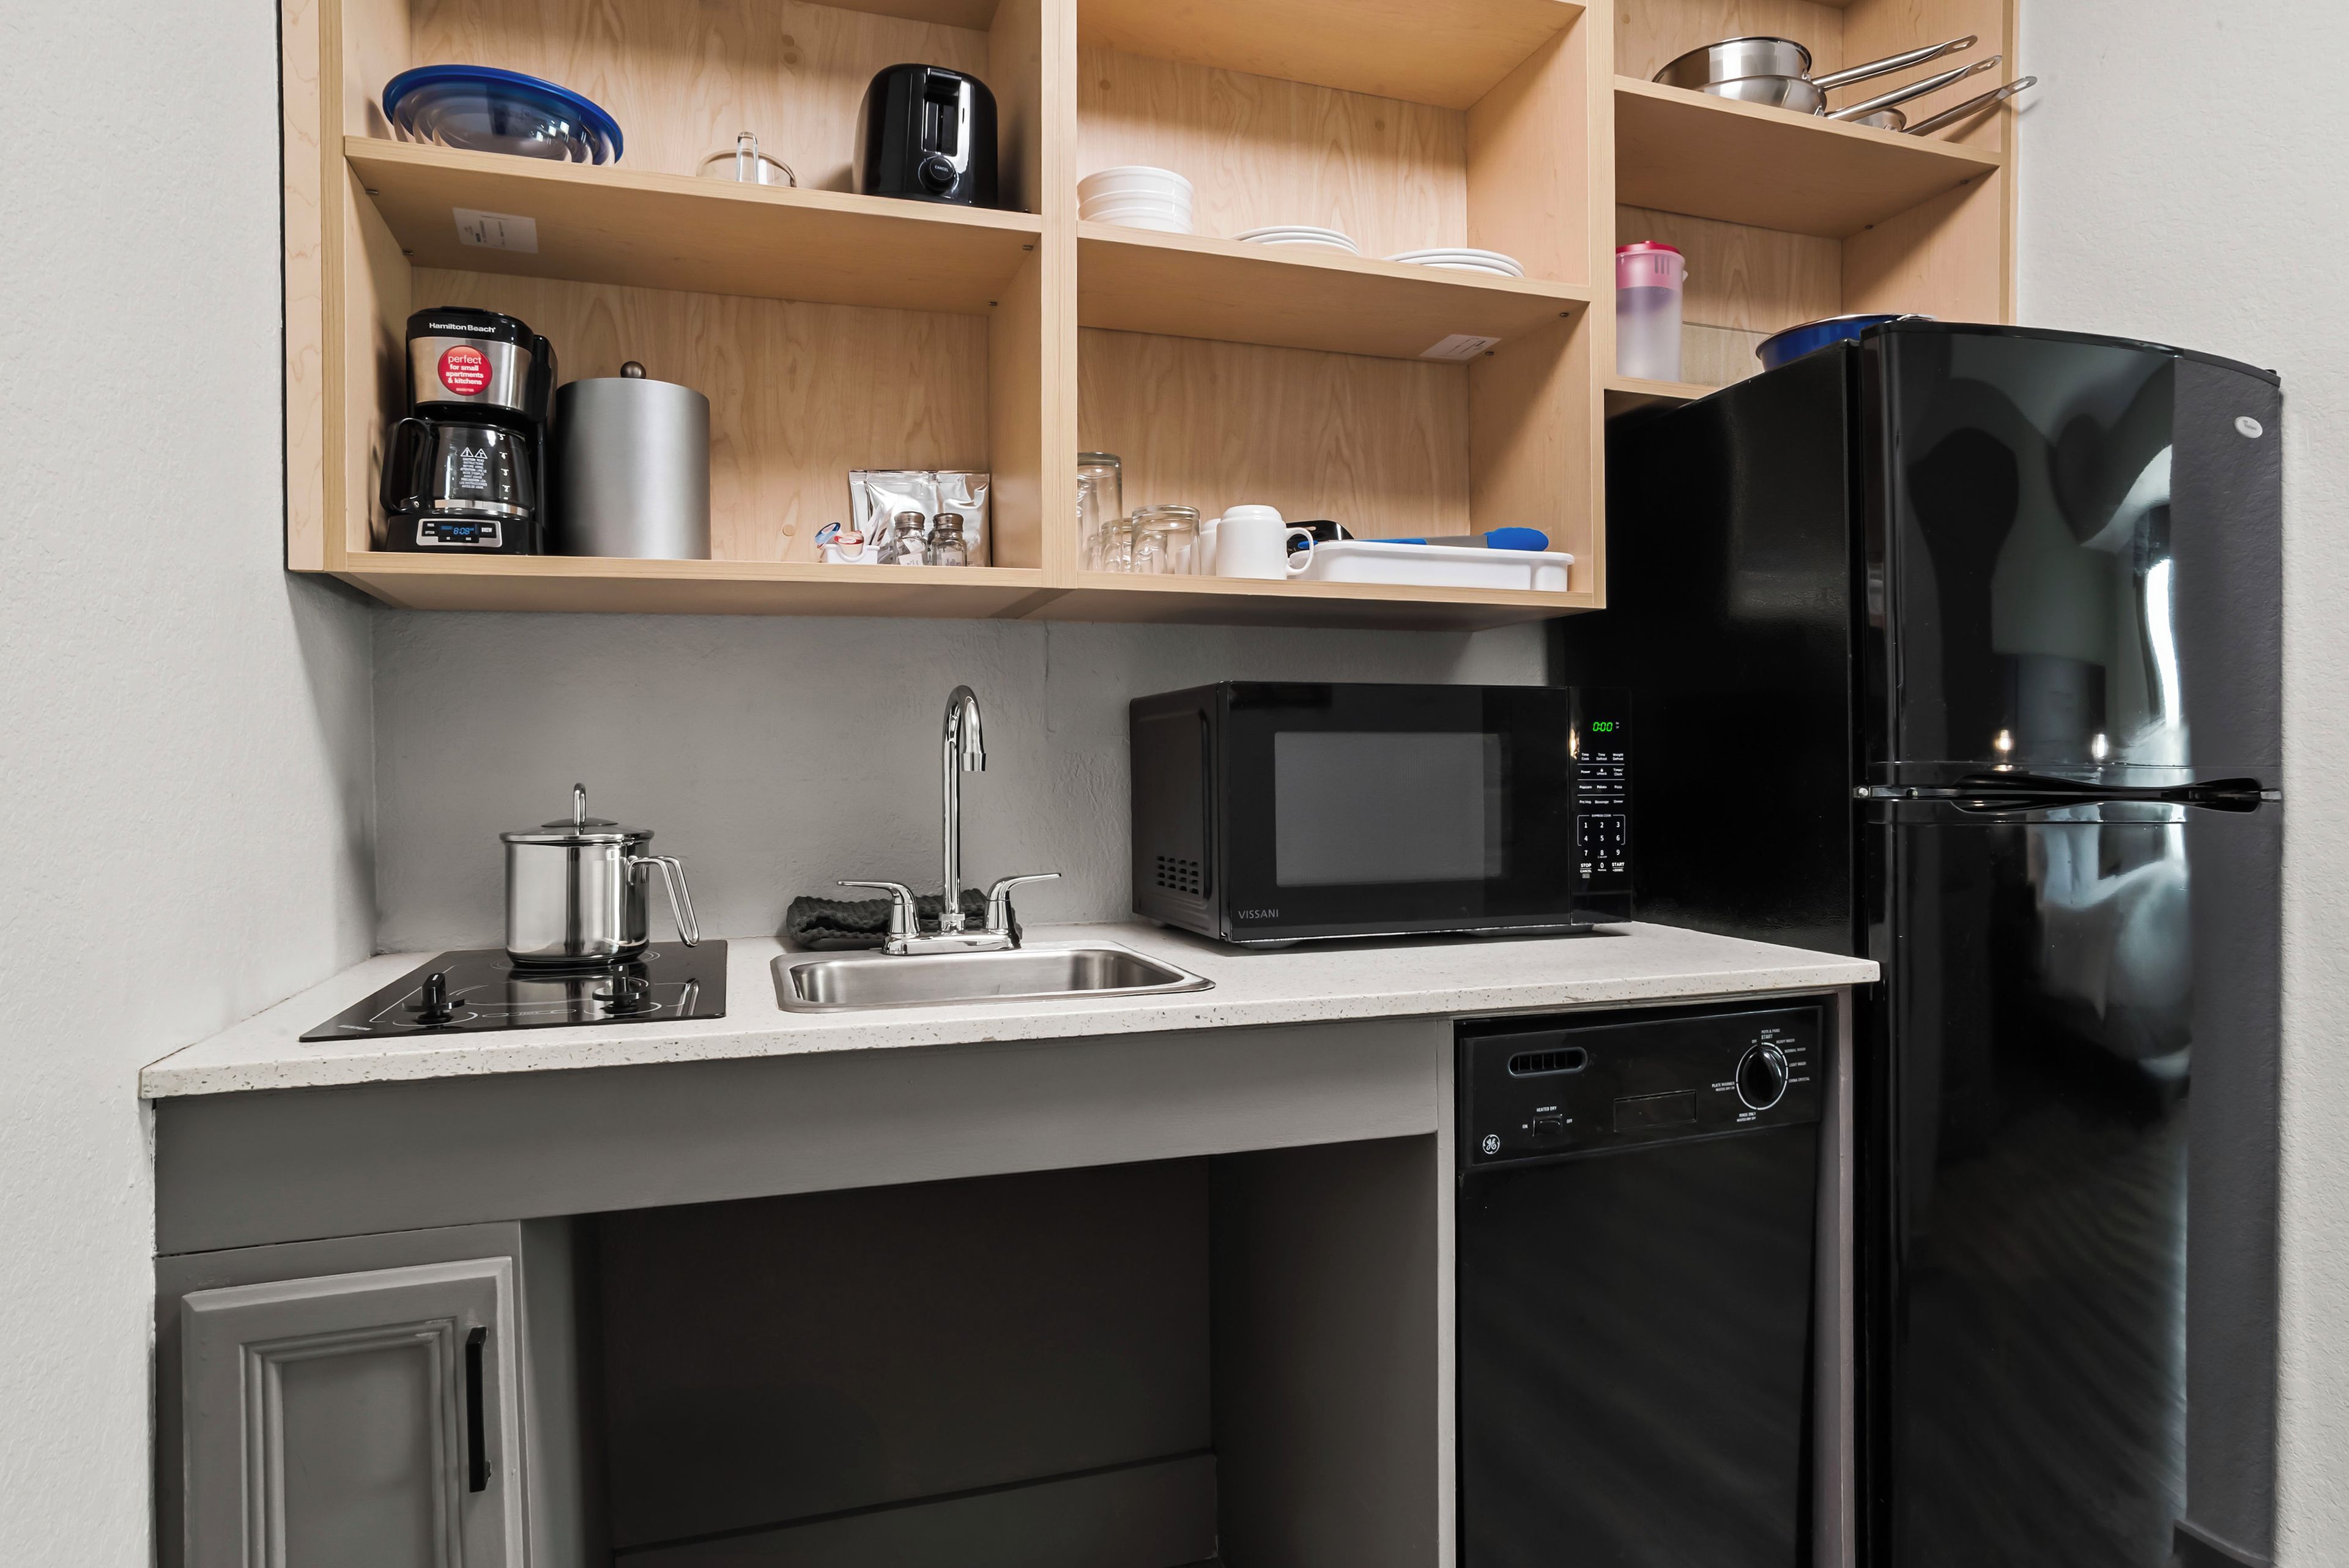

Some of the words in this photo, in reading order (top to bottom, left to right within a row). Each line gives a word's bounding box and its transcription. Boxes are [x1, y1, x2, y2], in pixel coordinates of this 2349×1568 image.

[448, 355, 481, 364] perfect
[1592, 722, 1613, 732] 0:00
[1238, 908, 1278, 919] VISSANI
